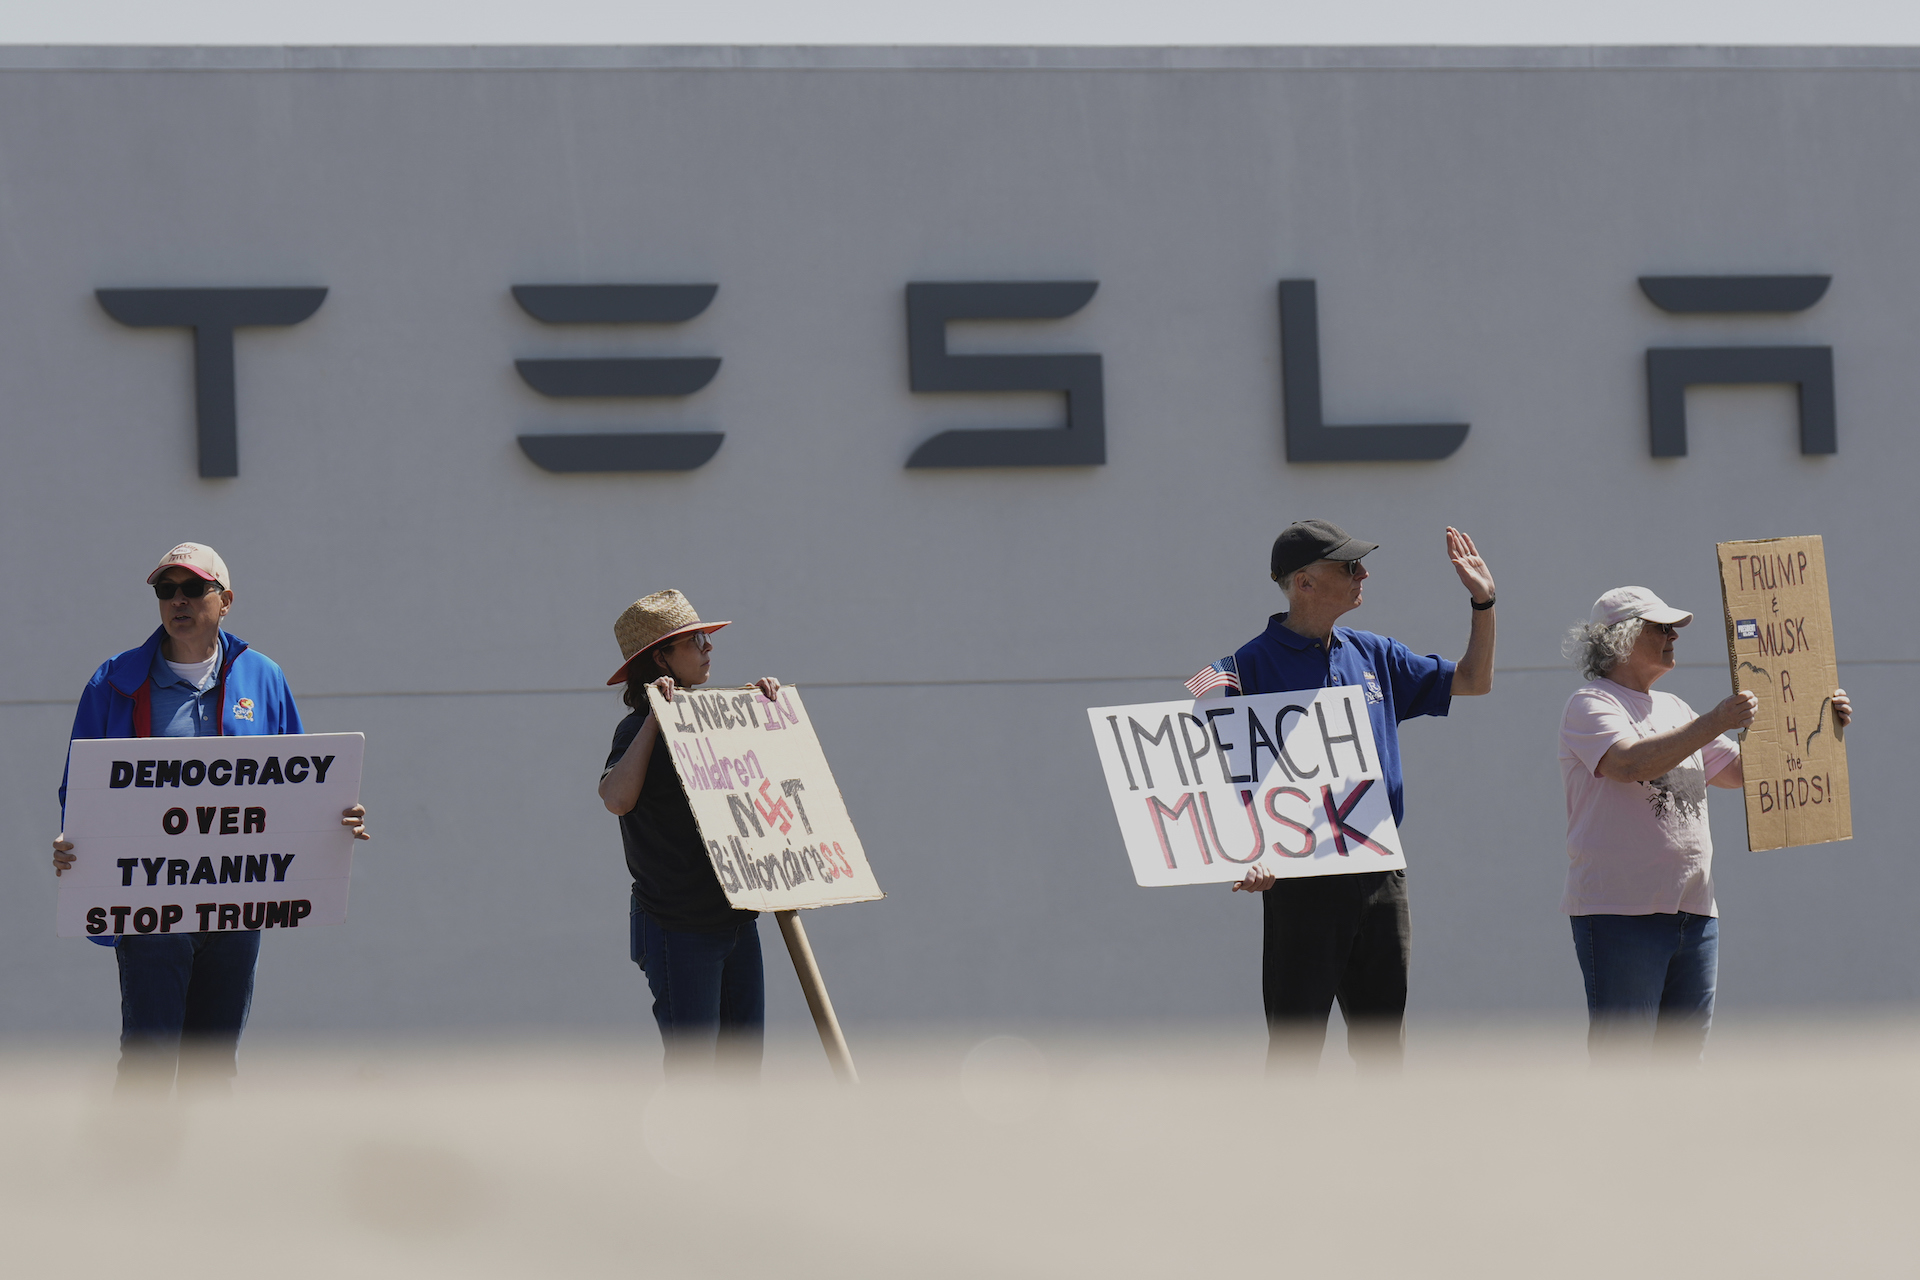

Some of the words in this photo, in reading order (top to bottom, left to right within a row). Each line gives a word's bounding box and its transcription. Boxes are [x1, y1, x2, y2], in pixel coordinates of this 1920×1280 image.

[94, 274, 1838, 480] TESLA
[1731, 551, 1807, 591] TRUMP
[1757, 617, 1810, 657] MUSK
[1781, 670, 1795, 703] R
[755, 691, 799, 731] IN
[1786, 716, 1799, 746] 4
[673, 737, 765, 791] Children
[1106, 697, 1368, 791] IMPEACH
[1786, 753, 1803, 772] the
[109, 755, 336, 789] DEMOCRACY
[1759, 772, 1831, 814] BIRDS!
[162, 806, 267, 835] OVER
[1145, 779, 1394, 869] MUSK
[117, 853, 296, 887] TYRANNY
[86, 904, 184, 935] STOP
[196, 899, 312, 932] TRUMP
